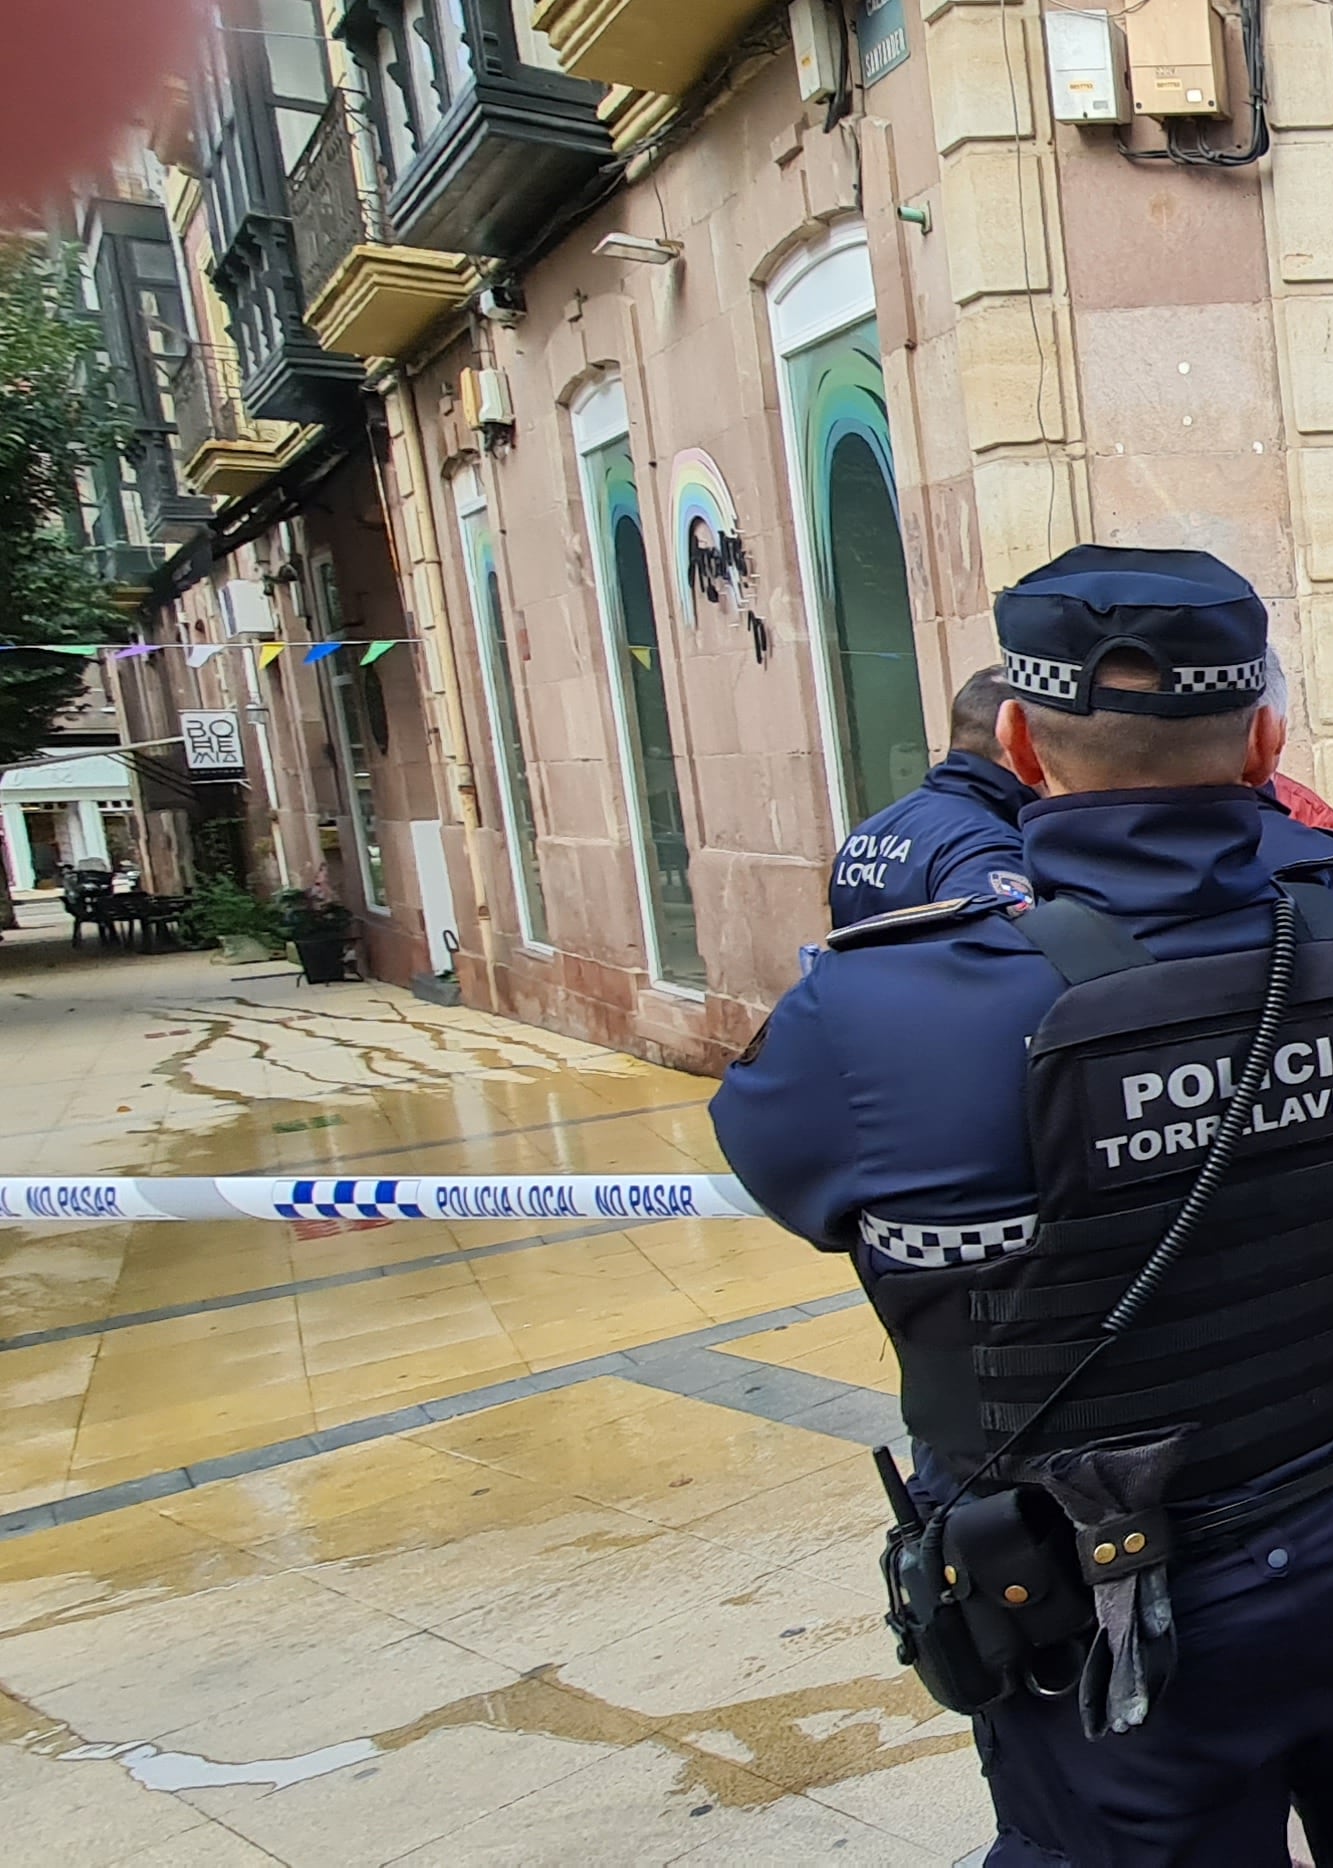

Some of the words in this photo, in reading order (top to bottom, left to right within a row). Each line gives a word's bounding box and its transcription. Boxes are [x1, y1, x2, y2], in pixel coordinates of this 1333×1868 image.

[865, 27, 906, 78] SANTANDER
[26, 1186, 59, 1217] NO
[57, 1186, 127, 1217] PASAR
[436, 1185, 519, 1217] POLICIA
[517, 1185, 588, 1217] LOCAL
[595, 1185, 628, 1216] NO
[630, 1184, 701, 1217] PASAR
